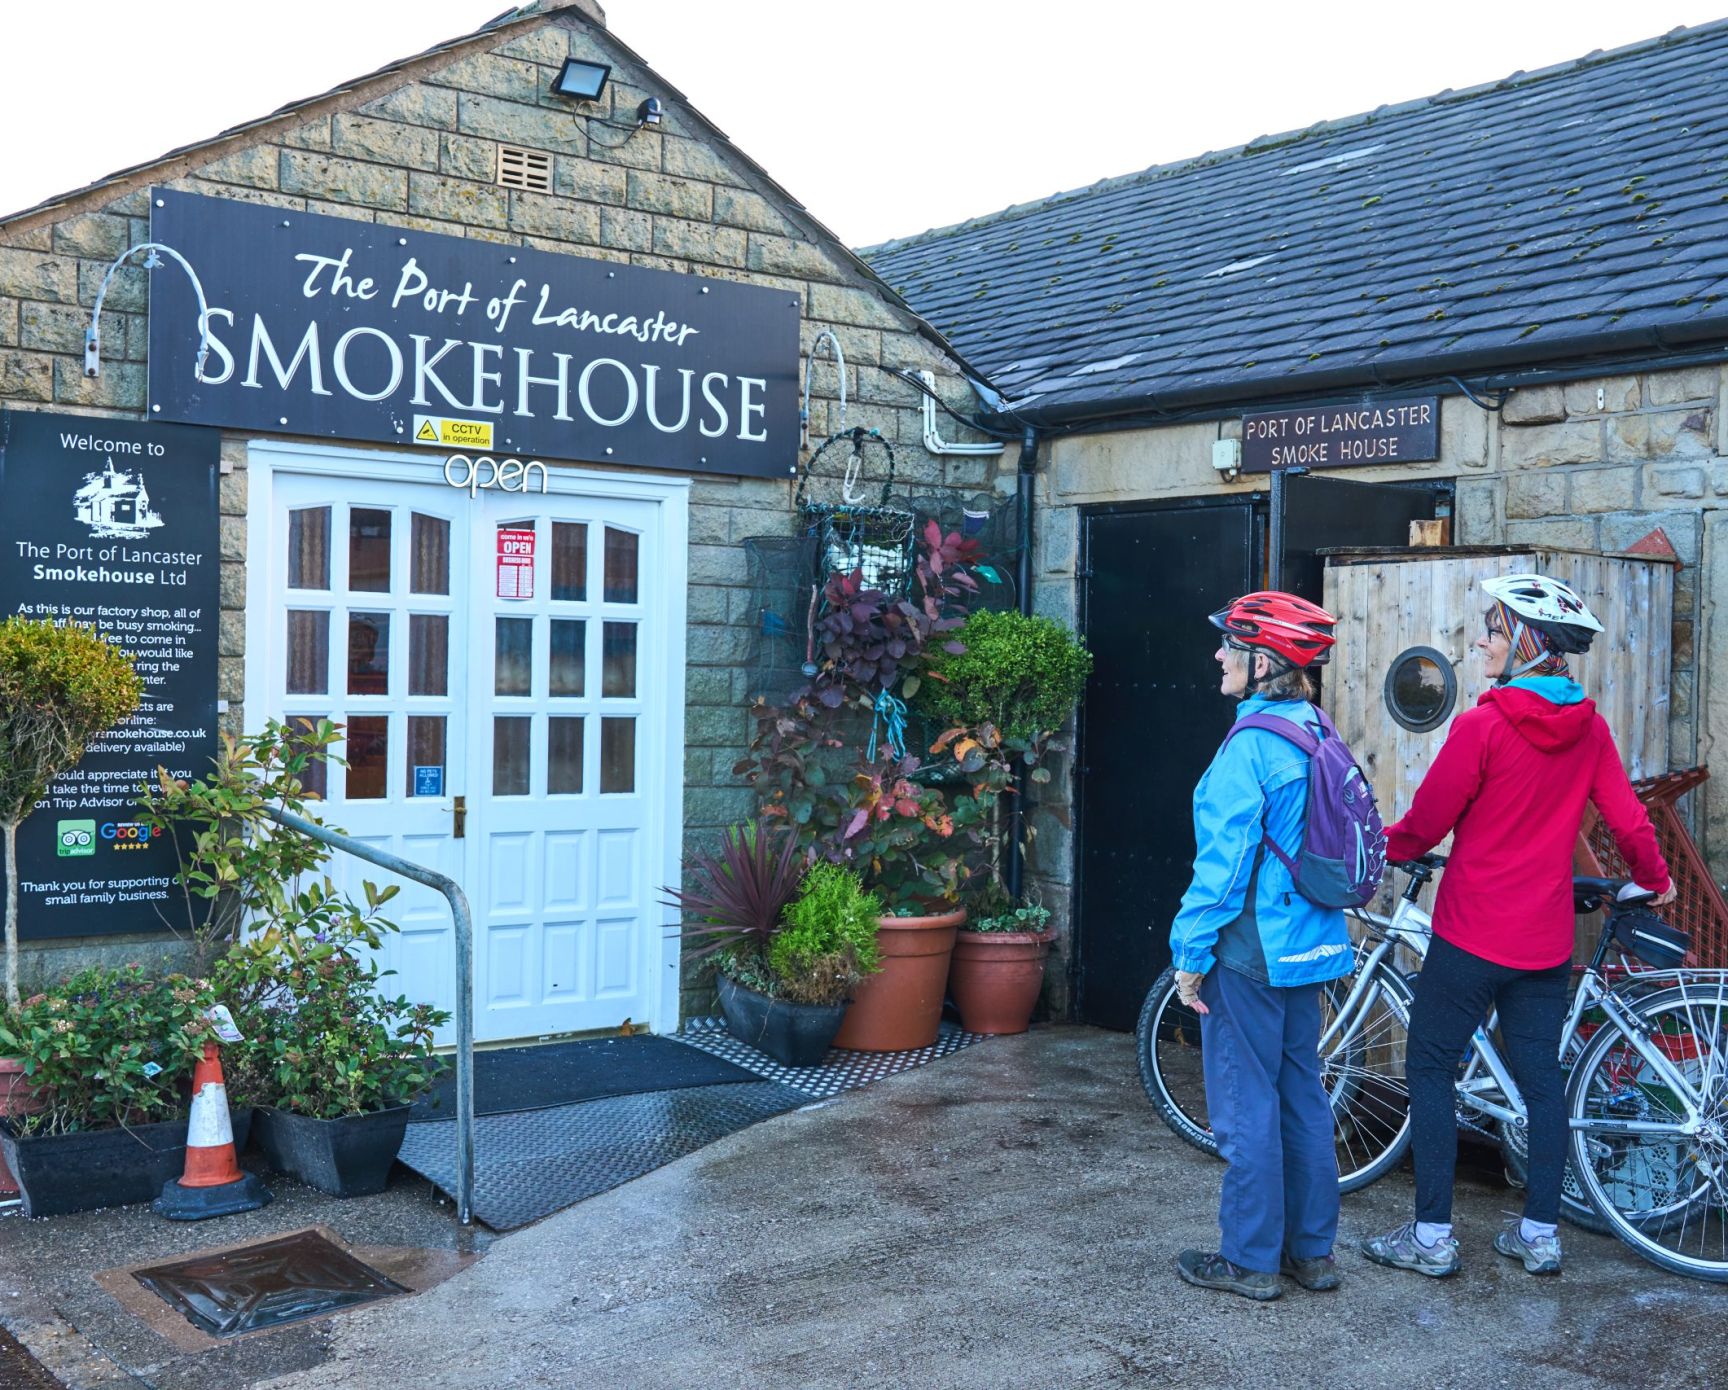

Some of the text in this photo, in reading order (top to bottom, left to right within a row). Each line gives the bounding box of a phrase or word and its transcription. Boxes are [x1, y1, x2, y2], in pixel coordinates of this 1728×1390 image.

[294, 247, 700, 346] The Port of Lancaster
[194, 306, 769, 442] SMOKEHOUSE
[451, 423, 482, 435] CCTV
[1247, 404, 1431, 440] PORT OF LANCASTER
[60, 433, 165, 456] Welcome to
[443, 433, 490, 445] in operation
[1271, 437, 1399, 465] SMOKE HOUSE
[444, 454, 548, 499] open
[16, 541, 202, 565] The Port of Lancaster
[503, 541, 532, 554] OPEN
[33, 564, 187, 586] Smokehouse Ltd
[18, 603, 201, 620] As this is our factory shop, all of
[41, 617, 67, 629] saff
[98, 619, 114, 630] be
[116, 620, 143, 632] busy
[146, 620, 202, 634] smoking...
[125, 634, 138, 644] to
[140, 636, 173, 645] come
[175, 635, 186, 645] in
[118, 648, 194, 658] ou would like
[136, 661, 159, 673] ring
[162, 661, 180, 672] the
[156, 703, 174, 711] are
[134, 742, 185, 752] available)
[56, 770, 85, 780] ould
[88, 770, 148, 783] appreciate
[150, 769, 158, 779] it
[170, 770, 192, 780] you
[53, 784, 78, 794] take
[81, 784, 100, 794] the
[103, 783, 130, 793] time
[34, 800, 51, 809] on
[53, 798, 76, 809] Trip
[79, 797, 123, 808] Advisor
[100, 821, 161, 841] Google
[59, 847, 94, 855] tripadvisor
[21, 881, 60, 893] Thank
[62, 881, 86, 893] you
[89, 878, 105, 889] for
[108, 876, 169, 890] supporting
[45, 891, 169, 905] small family business.
